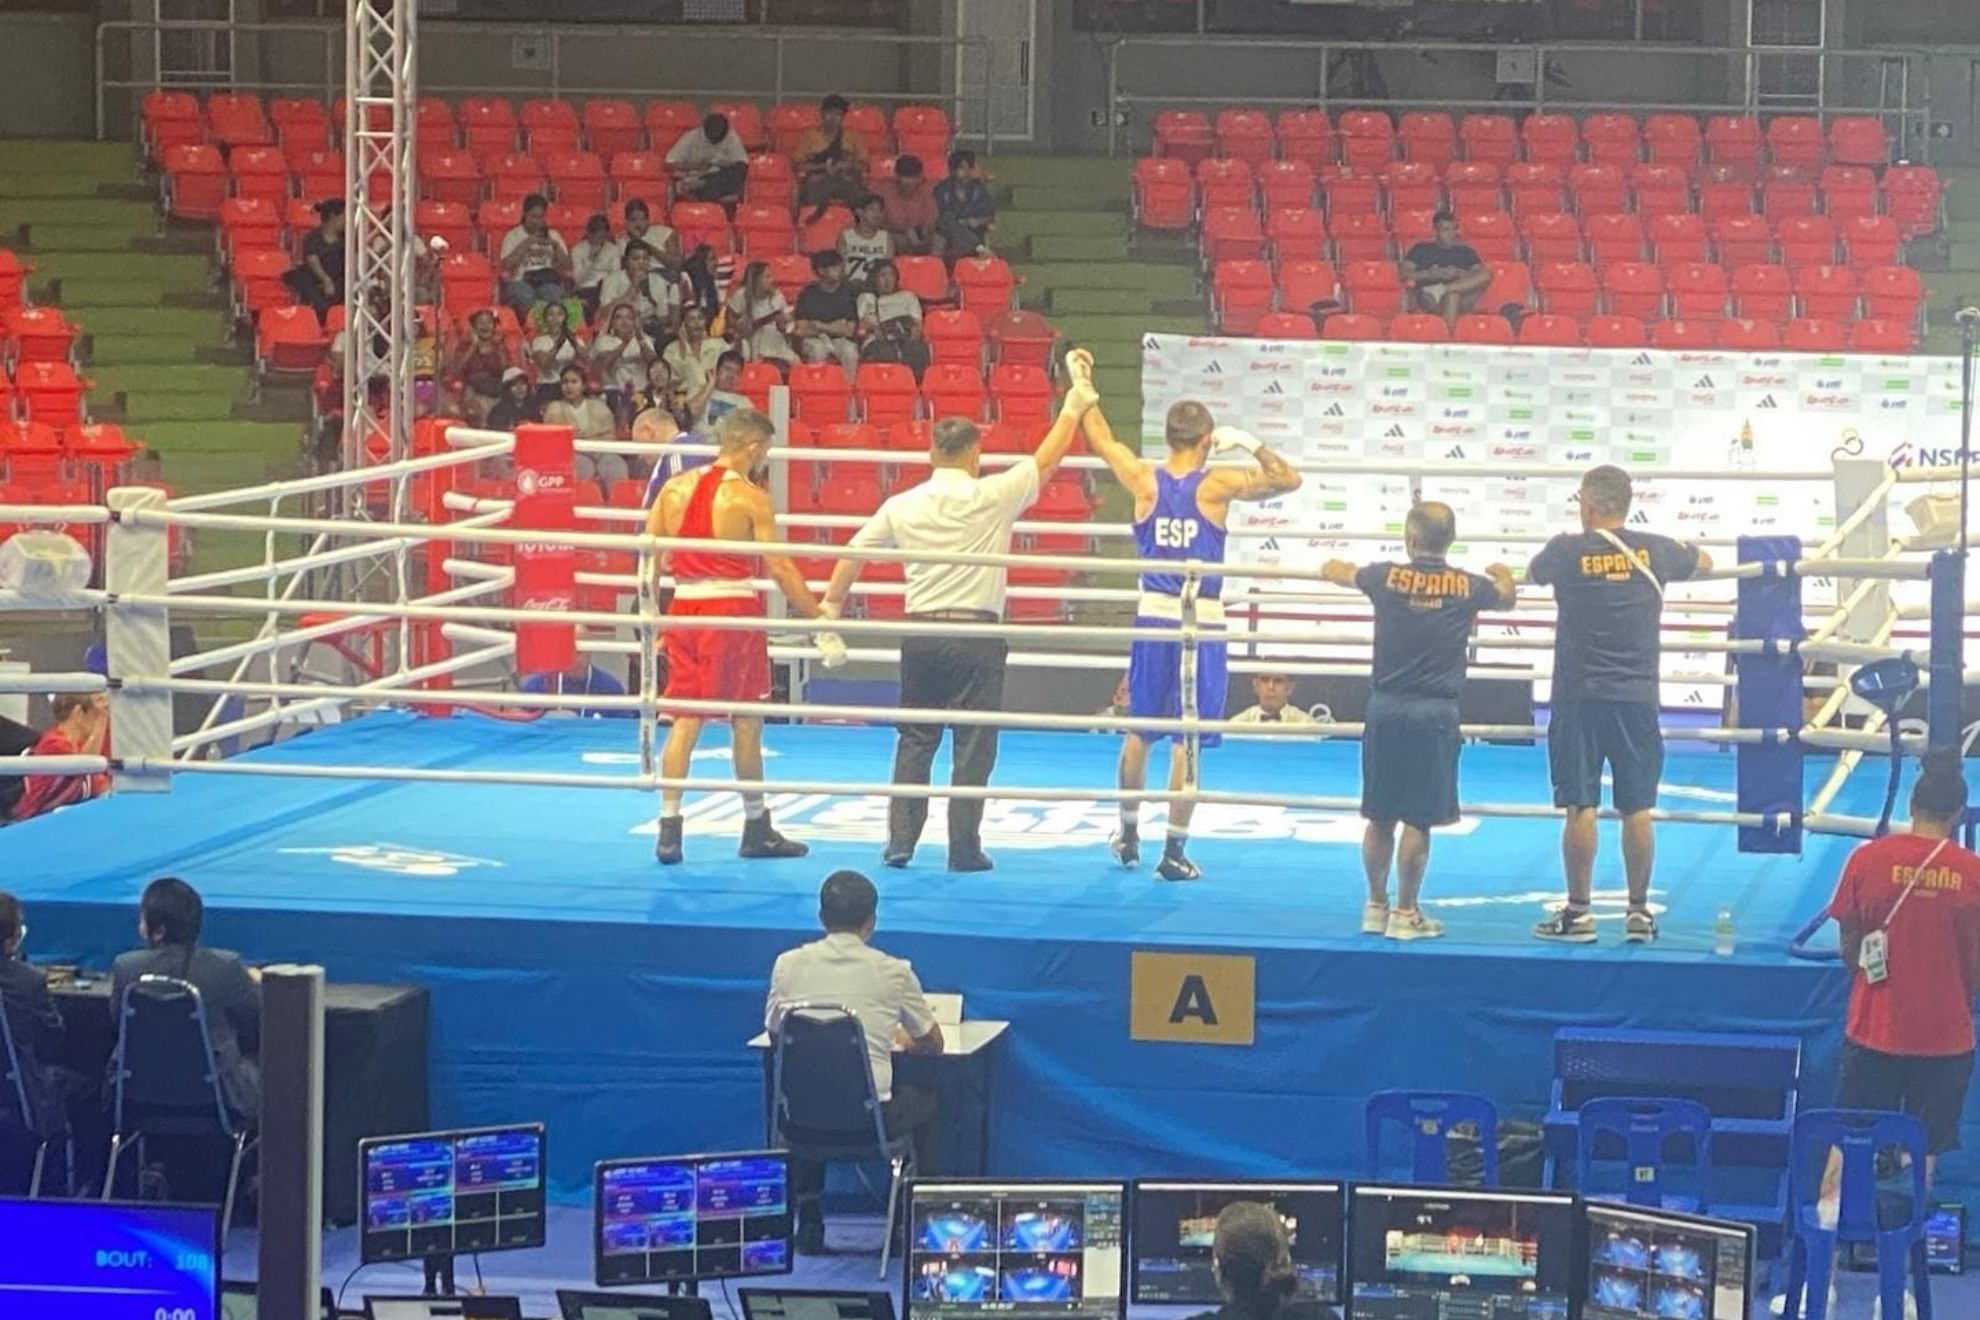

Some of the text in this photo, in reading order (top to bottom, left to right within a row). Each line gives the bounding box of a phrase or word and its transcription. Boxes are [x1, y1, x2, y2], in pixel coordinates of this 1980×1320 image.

[538, 475, 565, 488] GPP
[1155, 517, 1198, 548] ESP
[1581, 548, 1651, 575] ESPAA
[1169, 974, 1219, 1025] A
[96, 1249, 152, 1269] BOUT:
